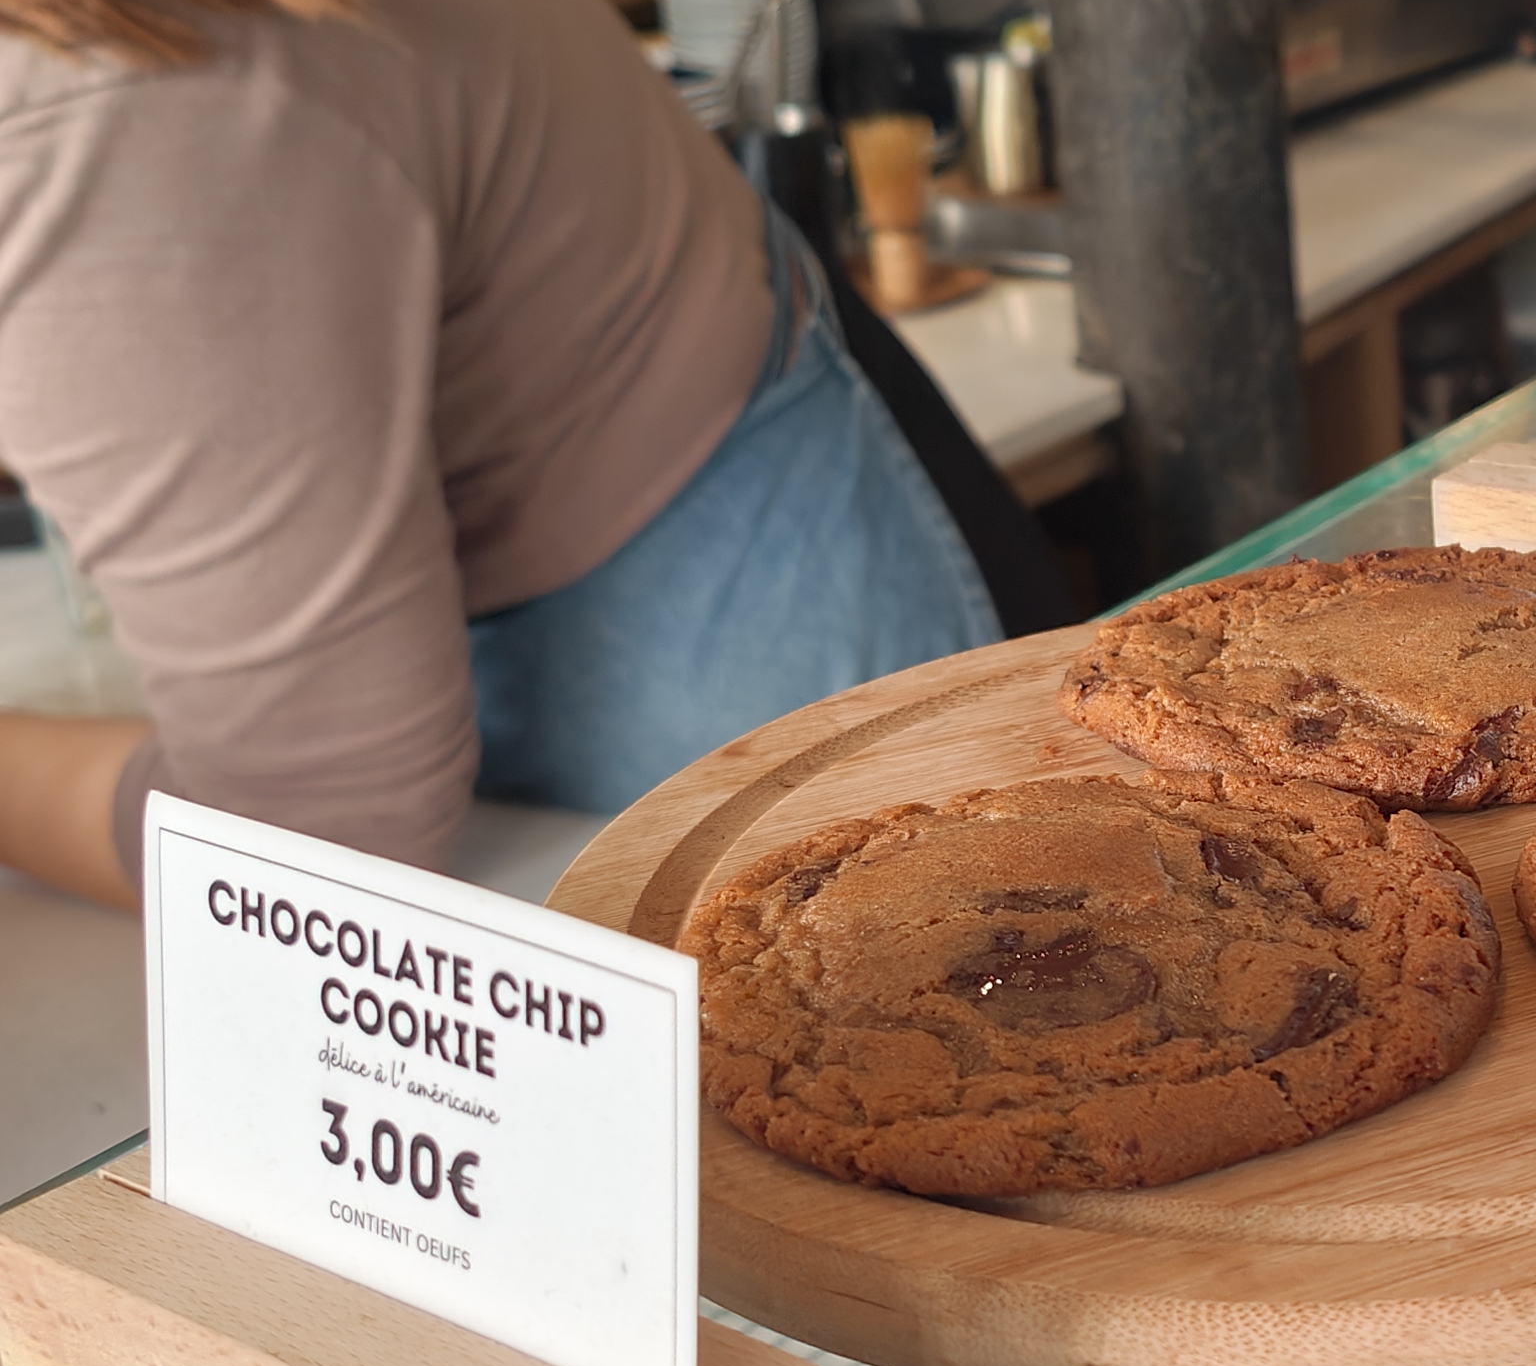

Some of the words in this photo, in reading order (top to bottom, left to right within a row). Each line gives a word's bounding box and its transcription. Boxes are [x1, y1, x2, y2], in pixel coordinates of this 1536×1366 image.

[207, 878, 473, 1006] CHOCOLATE
[488, 969, 607, 1047] CHIP
[318, 1036, 372, 1078] délice
[373, 1064, 387, 1084] à
[320, 977, 497, 1079] COOKIE
[320, 1097, 482, 1219] 3,00€
[329, 1199, 412, 1247] CONTIENT
[416, 1233, 472, 1271] OEUFS
